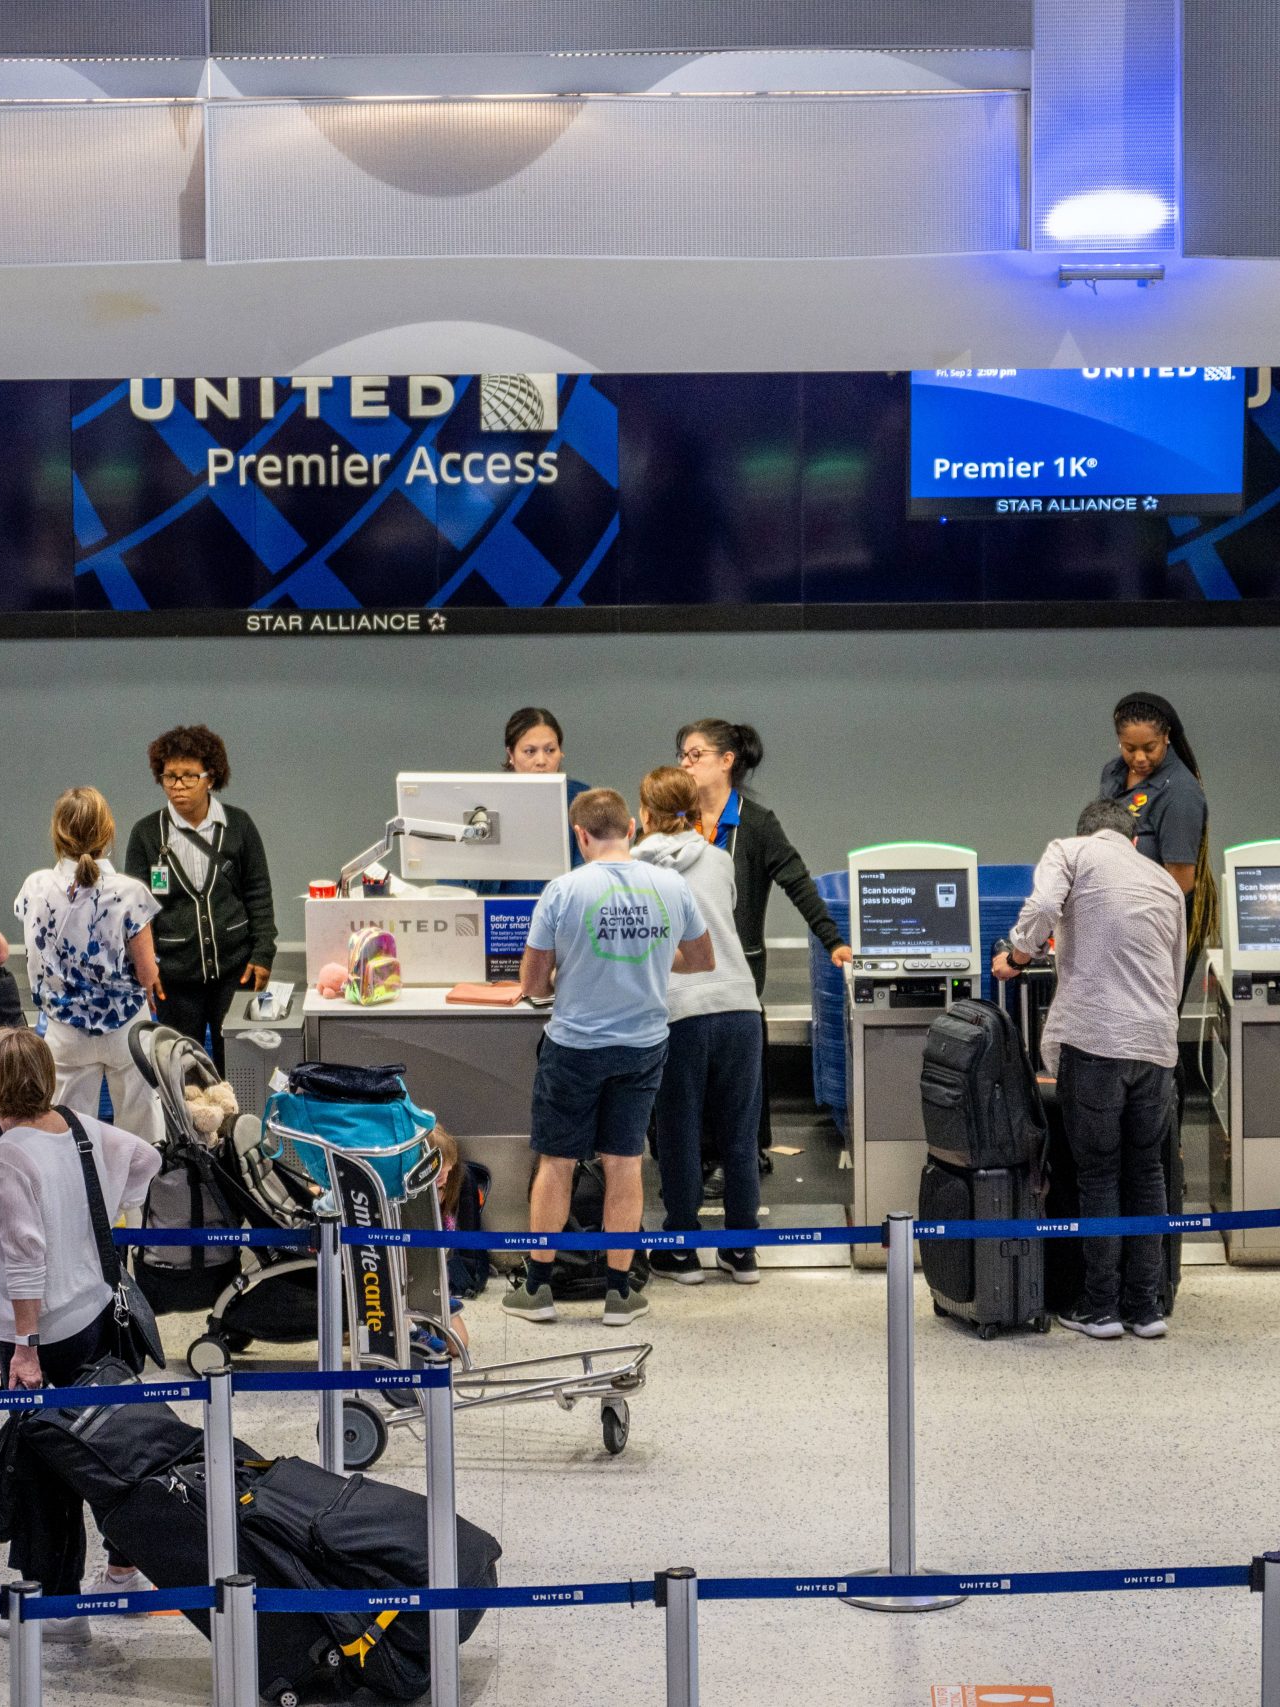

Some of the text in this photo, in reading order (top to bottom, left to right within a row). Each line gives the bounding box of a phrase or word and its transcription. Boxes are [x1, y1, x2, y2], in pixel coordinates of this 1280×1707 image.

[950, 368, 966, 378] Sep
[967, 368, 972, 376] 2
[977, 368, 998, 377] 2:09
[1000, 369, 1016, 379] pm
[1082, 367, 1197, 379] UNITED
[130, 375, 456, 420] UNITED
[208, 446, 558, 486] Premier Access
[934, 458, 1044, 480] Premier
[997, 498, 1137, 512] STAR ALLIANCE
[247, 614, 420, 630] STAR ALLIANCE
[883, 886, 916, 896] boarding
[892, 897, 912, 905] begin
[600, 906, 648, 916] CLIMATE
[350, 920, 448, 932] UNITED
[600, 916, 644, 926] ACTION
[597, 926, 670, 940] AT WORK
[351, 1190, 386, 1332] smrtecarte
[960, 1581, 998, 1589] UNITED
[1124, 1576, 1164, 1584] UNITED
